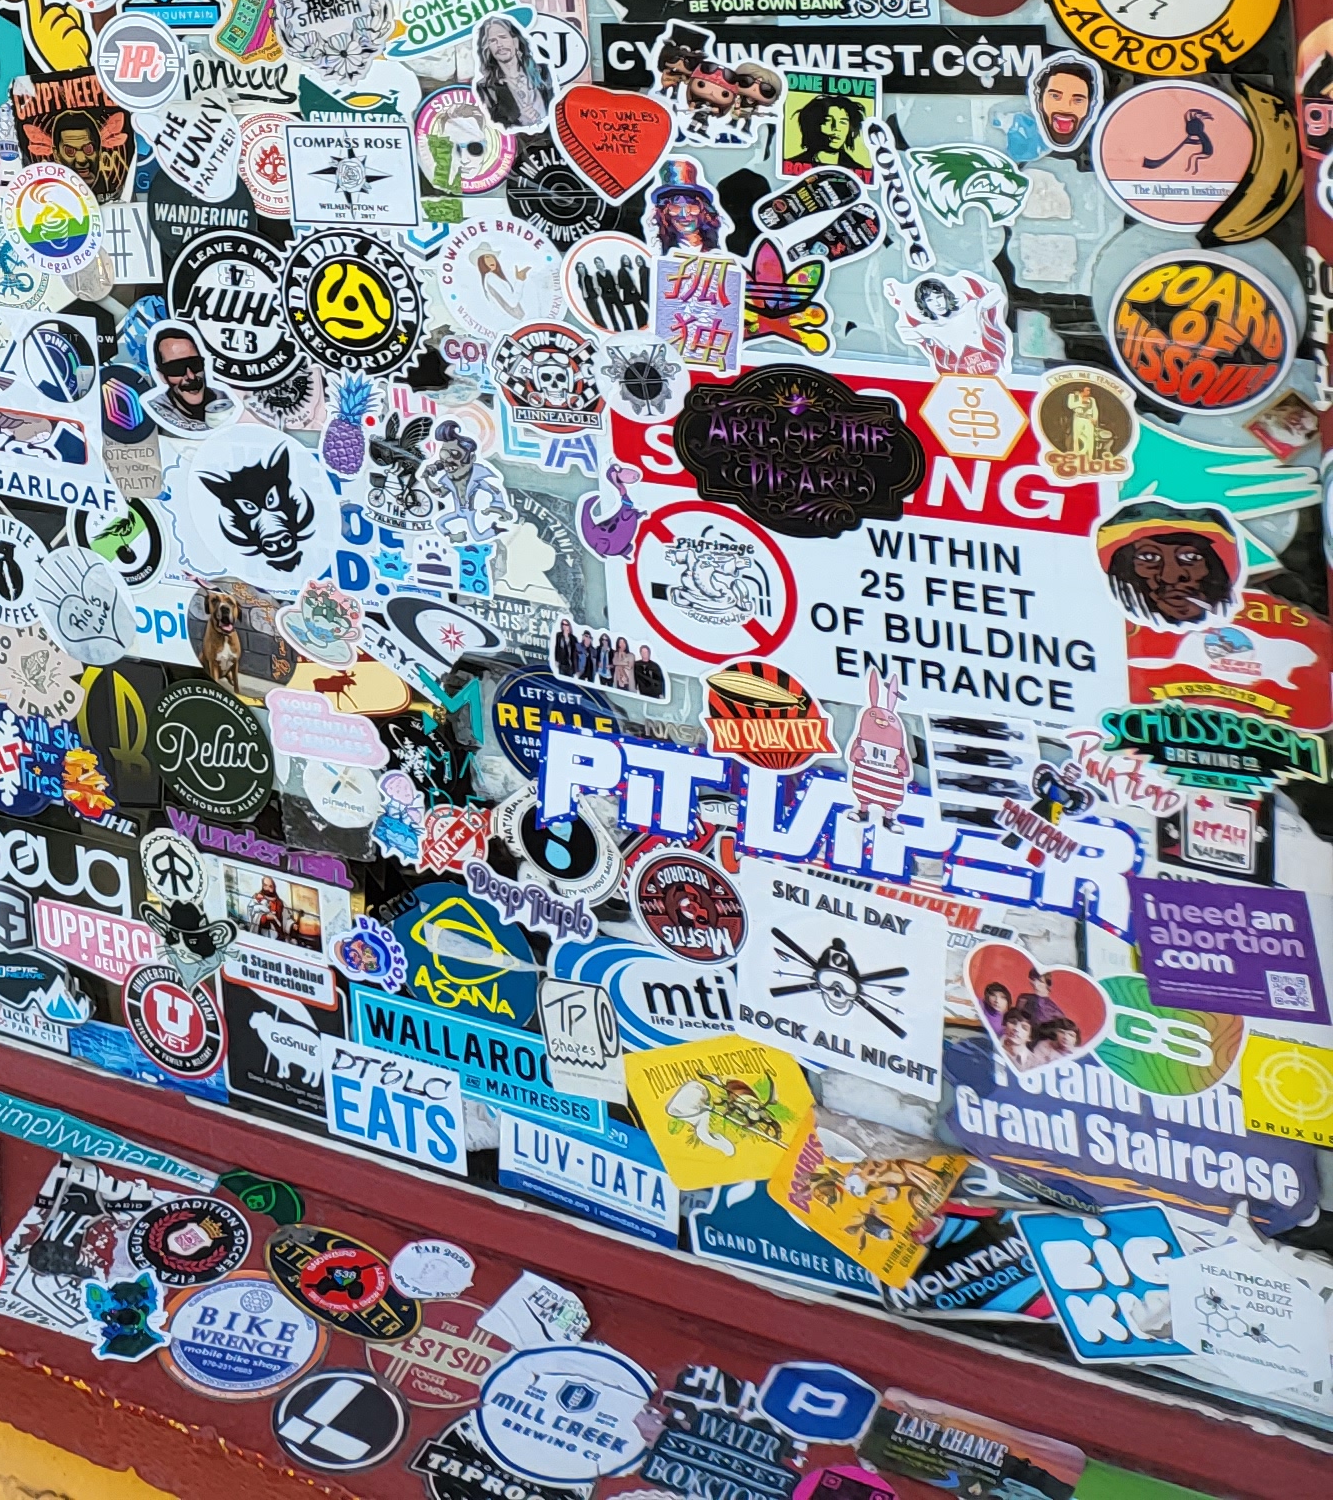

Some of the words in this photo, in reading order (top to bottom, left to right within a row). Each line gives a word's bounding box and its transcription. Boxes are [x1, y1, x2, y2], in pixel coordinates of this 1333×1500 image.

[788, 75, 822, 94] ONE
[827, 78, 875, 97] LOVE
[292, 138, 358, 151] COMPASS
[364, 138, 402, 150] ROSE
[155, 205, 251, 228] WANDERING
[514, 409, 599, 428] MINNEAPOLIS
[867, 528, 1021, 576] WITHIN
[860, 570, 905, 601] 25
[925, 578, 1034, 619] FEET
[810, 601, 871, 634] OF
[883, 609, 1097, 672] BUILDING
[836, 650, 1074, 711] ENTRANCE
[158, 722, 267, 775] Relax
[713, 719, 739, 750] NO
[742, 716, 827, 753] QUARTER
[772, 881, 808, 906] SKI
[817, 891, 864, 925] ALL
[867, 906, 912, 932] DAY
[1250, 909, 1296, 931] an
[1150, 924, 1306, 958] abortion
[1155, 950, 1234, 973] .com
[642, 959, 734, 1022] mti
[739, 1003, 808, 1041] ROCK
[814, 1022, 861, 1058] ALL
[867, 1041, 938, 1086] NIGHT
[336, 1081, 461, 1156] EATS
[483, 1078, 592, 1122] MATTRESSES
[957, 1084, 1099, 1159] Grand
[1105, 1116, 1301, 1203] Staircase
[191, 1328, 292, 1361] WRENCH
[199, 1306, 299, 1341] BIKE
[492, 1391, 549, 1425] MILL
[555, 1416, 630, 1453] CREEK
[698, 1412, 781, 1463] WATER
[895, 1412, 940, 1443] LAST
[943, 1429, 1009, 1466] CHANCE
